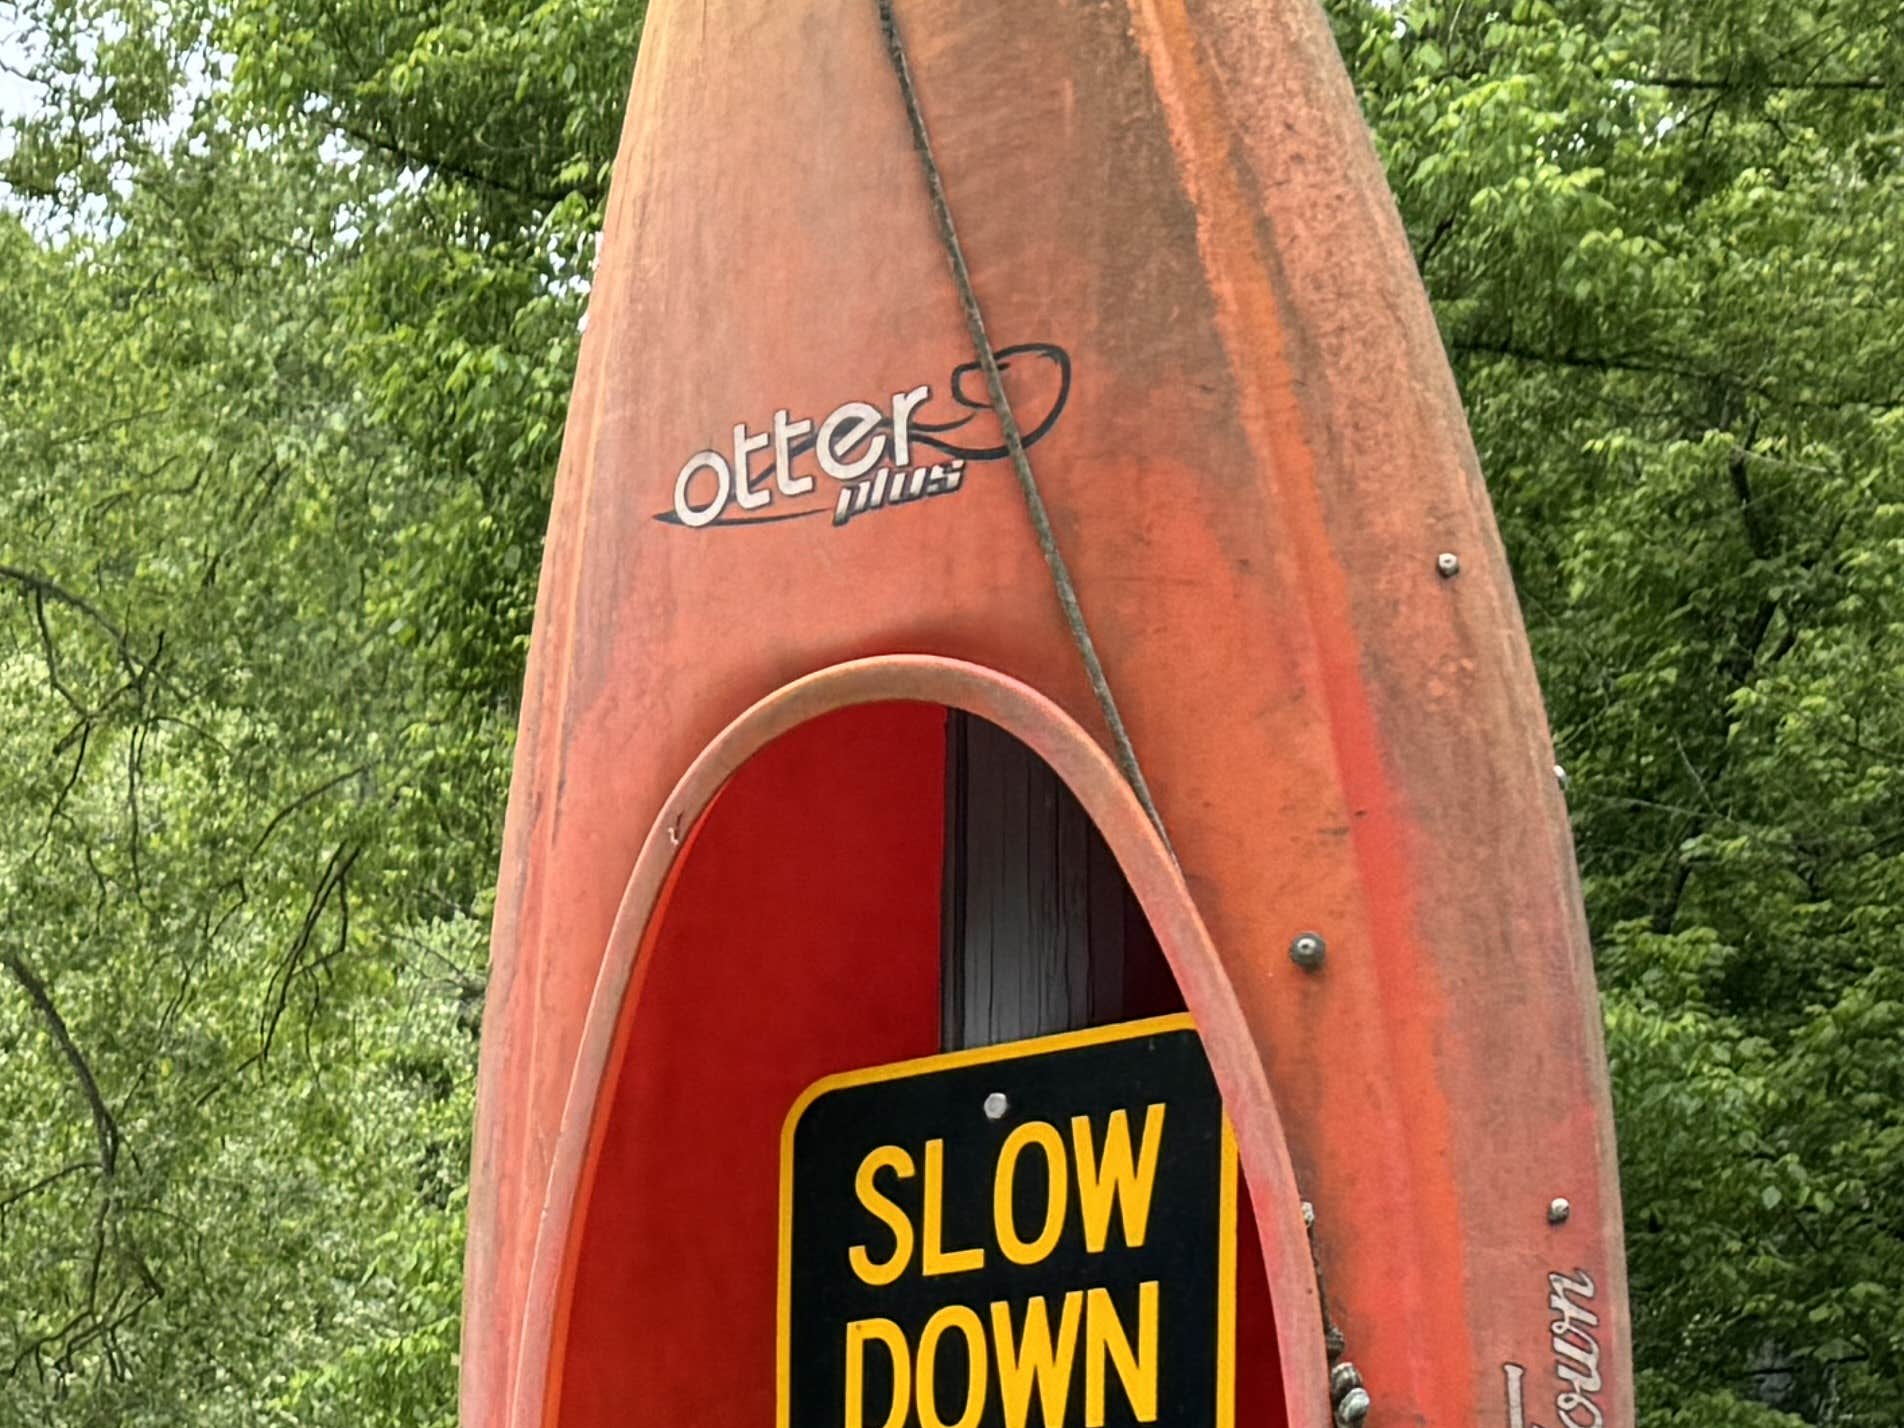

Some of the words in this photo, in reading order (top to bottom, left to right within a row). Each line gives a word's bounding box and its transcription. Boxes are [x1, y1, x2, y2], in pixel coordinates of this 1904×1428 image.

[673, 385, 930, 527] otter
[832, 459, 965, 527] plus
[848, 1102, 1167, 1286] SLOW
